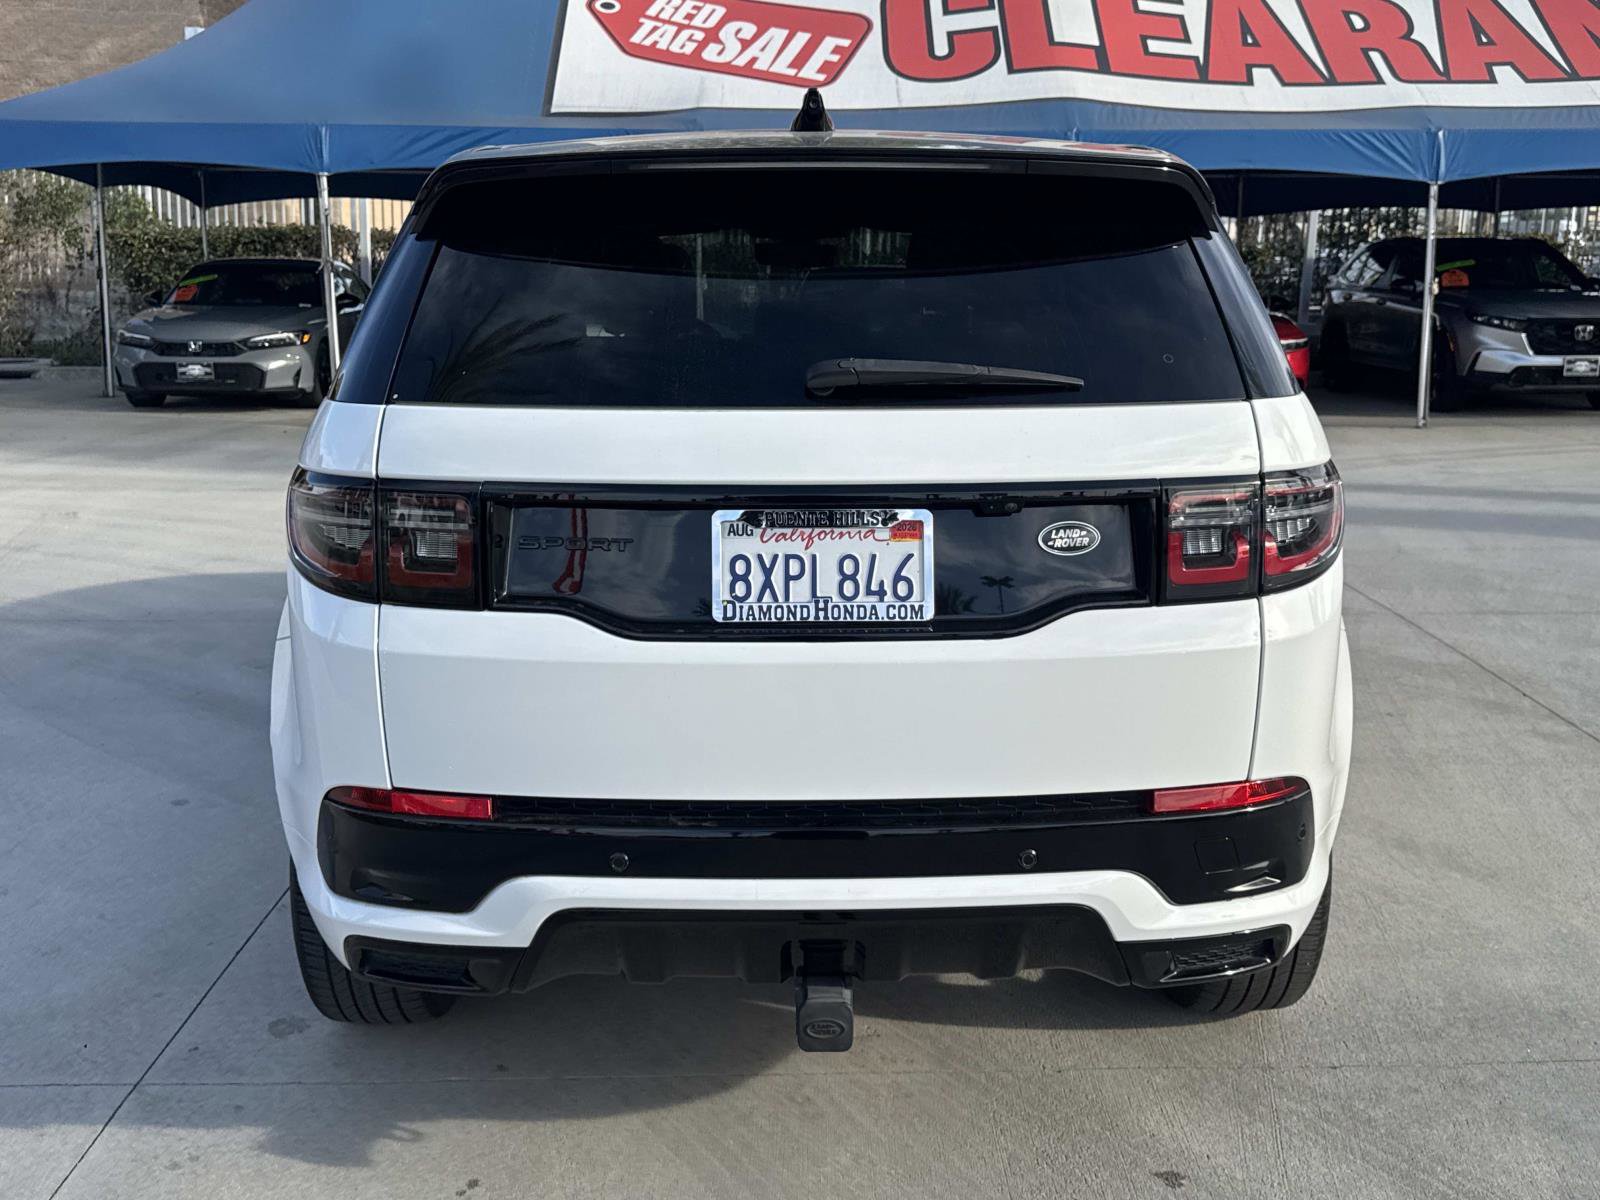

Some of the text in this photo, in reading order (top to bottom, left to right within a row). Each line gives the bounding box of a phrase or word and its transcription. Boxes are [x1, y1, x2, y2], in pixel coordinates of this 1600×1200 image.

[645, 0, 727, 29] RED
[629, 18, 852, 82] TAG SALE
[764, 511, 881, 527] PUENTE HILLS
[727, 523, 754, 537] AUG
[1051, 529, 1080, 538] LAND
[519, 536, 634, 552] SPORT
[760, 528, 890, 550] California
[1054, 538, 1089, 547] ROVER
[729, 553, 915, 603] 8XPL846
